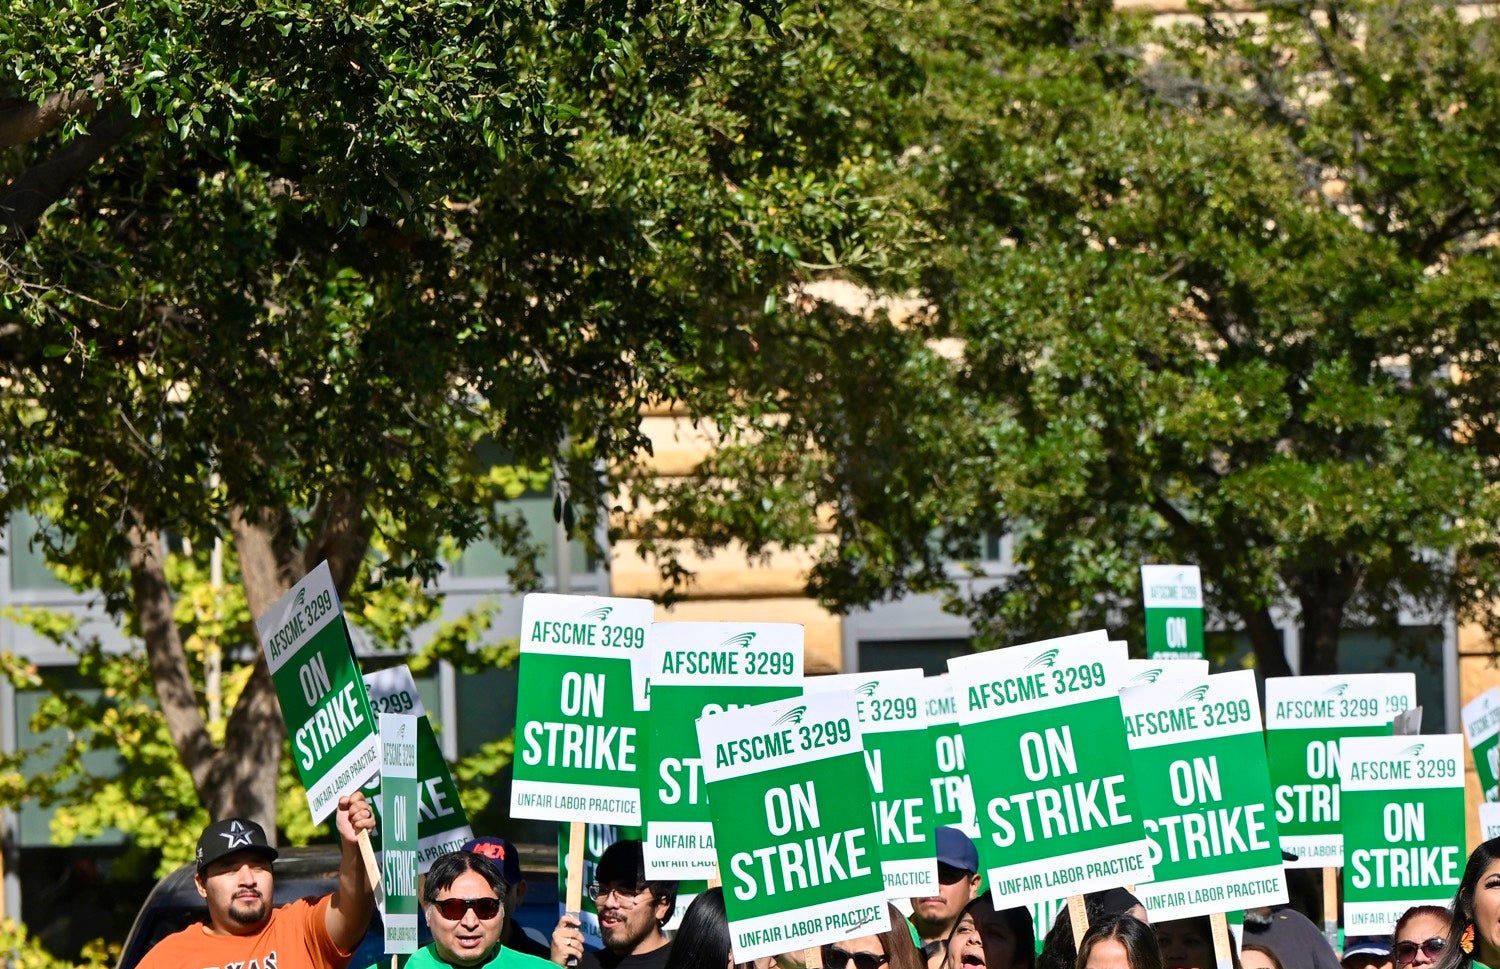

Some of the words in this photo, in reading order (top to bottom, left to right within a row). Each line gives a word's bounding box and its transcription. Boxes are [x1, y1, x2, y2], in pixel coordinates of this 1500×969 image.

[269, 612, 306, 661] AFSCME
[304, 590, 332, 627] 3299
[532, 621, 596, 646] AFSCME
[601, 625, 644, 649] 3299
[1166, 617, 1187, 649] ON
[299, 651, 331, 707] ON
[662, 651, 738, 674] AFSCME
[745, 652, 794, 675] 3299
[560, 672, 605, 718] ON
[968, 672, 1049, 711] AFSCME
[1054, 662, 1106, 693] 3299
[296, 681, 364, 771] STRIKE
[871, 697, 917, 721] 3299
[1124, 707, 1197, 738] AFSCME
[1203, 699, 1250, 727] 3299
[1276, 700, 1336, 719] AFSCME
[1341, 699, 1378, 717] 3299
[384, 743, 401, 766] AFSCME
[403, 743, 414, 767] 3299
[522, 721, 636, 772] STRIKE
[715, 730, 795, 768] AFSCME
[800, 718, 851, 750] 3299
[1019, 725, 1078, 782] ON
[312, 785, 334, 812] UNFAIR
[330, 767, 351, 795] LABOR
[350, 746, 377, 778] PRACTICE
[1169, 756, 1222, 807] ON
[1351, 761, 1412, 781] AFSCME
[1417, 759, 1456, 779] 3299
[394, 795, 406, 841] ON
[518, 793, 552, 808] UNFAIR
[554, 794, 585, 810] LABOR
[589, 797, 636, 814] PRACTICE
[764, 781, 820, 836] ON
[987, 775, 1132, 848] STRIKE
[1383, 802, 1425, 842] ON
[655, 835, 695, 848] UNFAIR
[1143, 803, 1270, 865] STRIKE
[1308, 846, 1337, 857] LABOR
[386, 851, 416, 896] STRIKE
[730, 828, 871, 901] STRIKE
[882, 871, 931, 887] PRACTICE
[998, 874, 1042, 896] UNFAIR
[1044, 866, 1084, 888] LABOR
[1087, 854, 1144, 880] PRACTICE
[1351, 846, 1460, 889] STRIKE
[1145, 889, 1185, 911] UNFAIR
[1188, 883, 1225, 904] LABOR
[1227, 878, 1280, 900] PRACTICE
[739, 926, 782, 948] UNFAIR
[784, 918, 823, 939] LABOR
[825, 905, 881, 930] PRACTICE
[1351, 912, 1384, 925] UNFAIR
